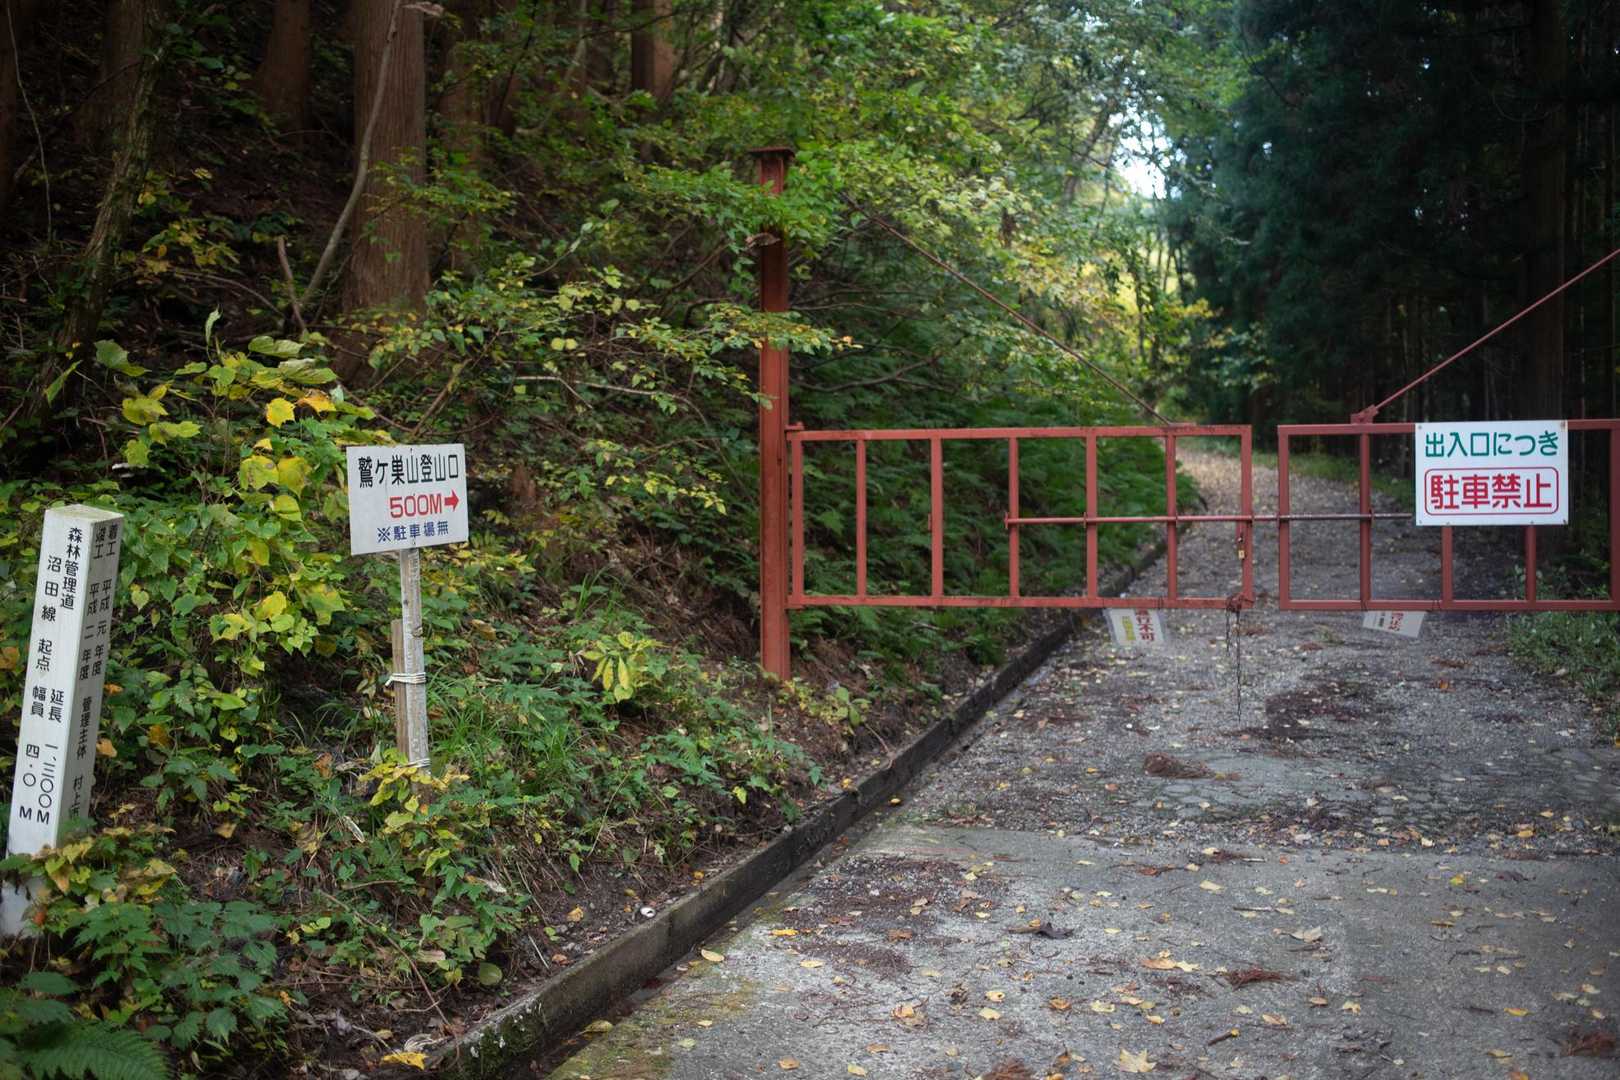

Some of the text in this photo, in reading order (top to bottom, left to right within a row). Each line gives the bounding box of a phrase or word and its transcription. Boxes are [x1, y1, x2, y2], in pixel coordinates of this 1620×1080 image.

[1425, 430, 1559, 458] 出入口につき
[389, 493, 443, 519] 500M
[1430, 473, 1553, 510] 駐車禁止
[60, 527, 82, 611] 森林管理道
[36, 555, 62, 672] 沼田線 起点
[30, 685, 47, 719] 幅員
[48, 688, 65, 724] 延長
